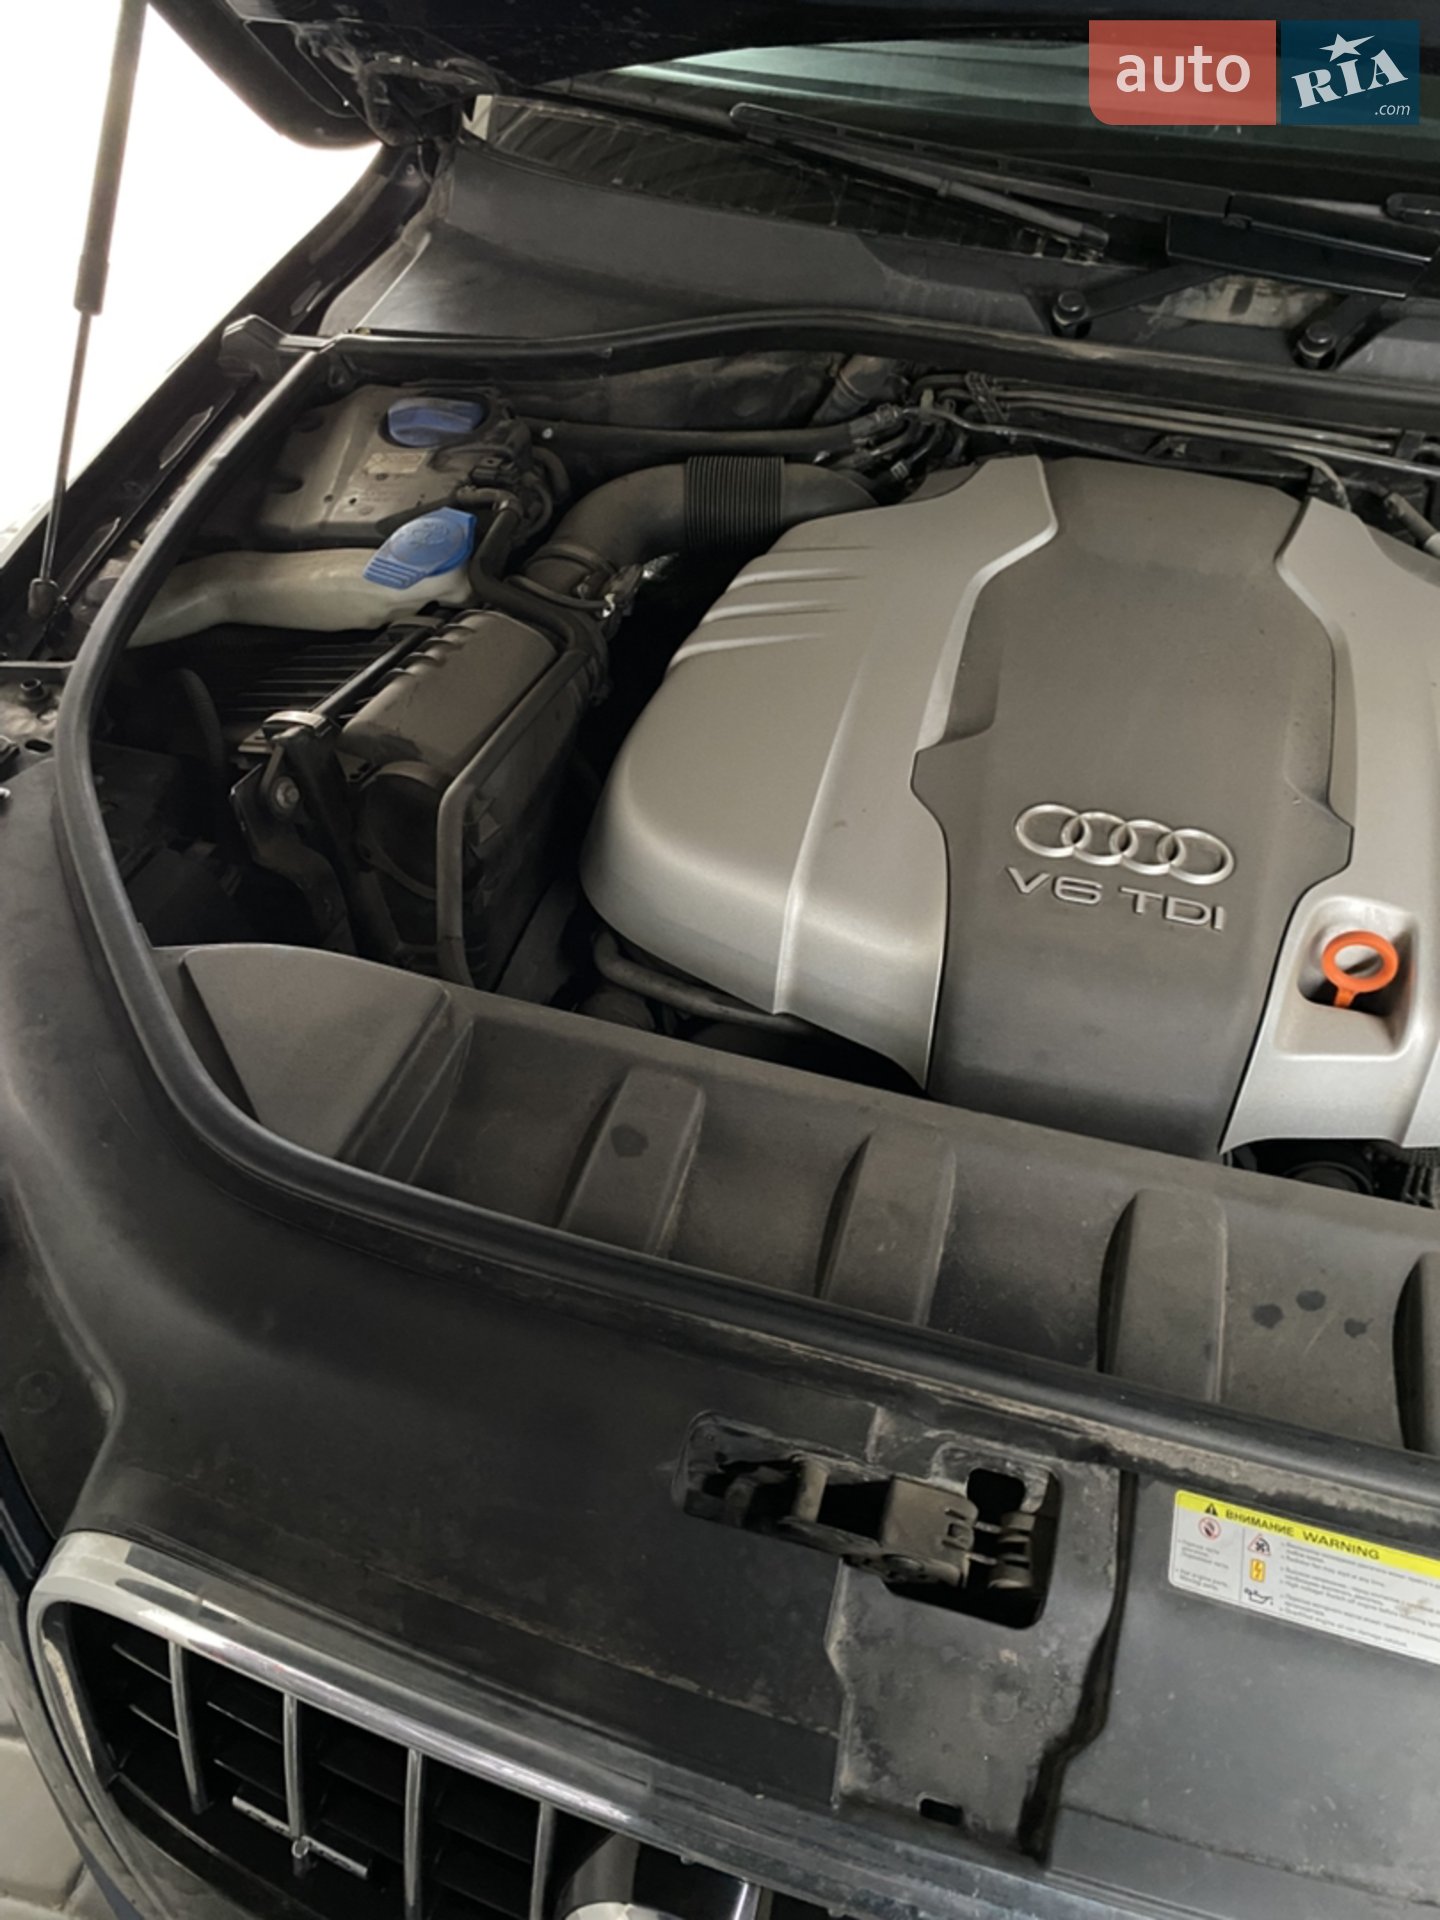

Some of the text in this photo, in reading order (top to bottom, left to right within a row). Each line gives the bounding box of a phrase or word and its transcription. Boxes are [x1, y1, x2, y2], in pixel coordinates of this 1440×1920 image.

[1006, 867, 1225, 931] V6 TDI
[1225, 1509, 1380, 1560] ВНИМАНИЕ WARNING
